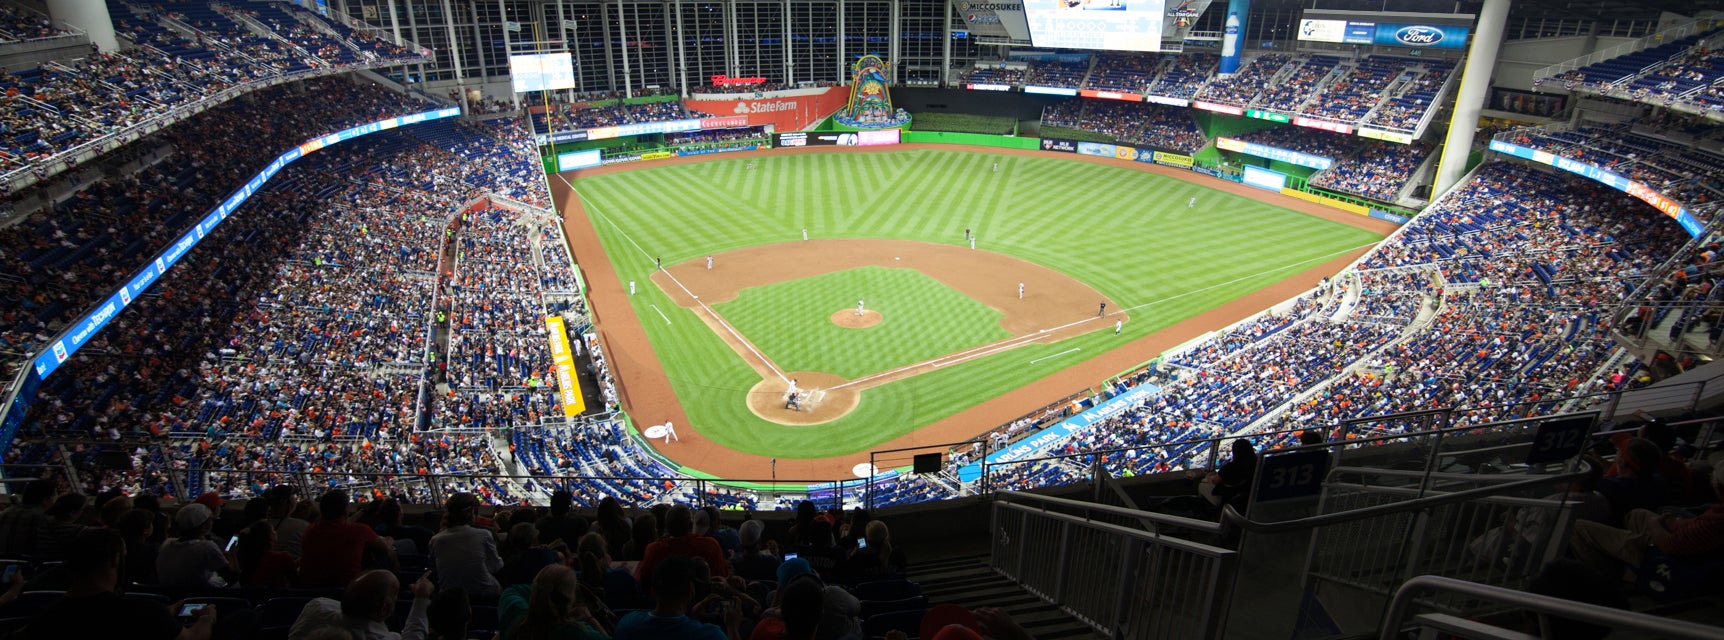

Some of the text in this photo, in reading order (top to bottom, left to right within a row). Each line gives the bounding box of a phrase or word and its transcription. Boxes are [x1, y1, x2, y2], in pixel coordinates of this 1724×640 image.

[970, 3, 1021, 11] MICCOSUKEE
[1403, 28, 1434, 44] Ford
[1082, 389, 1150, 421] MARLINS PARK
[1030, 431, 1060, 448] PARK
[1540, 429, 1579, 452] 312
[1270, 463, 1314, 489] 313
